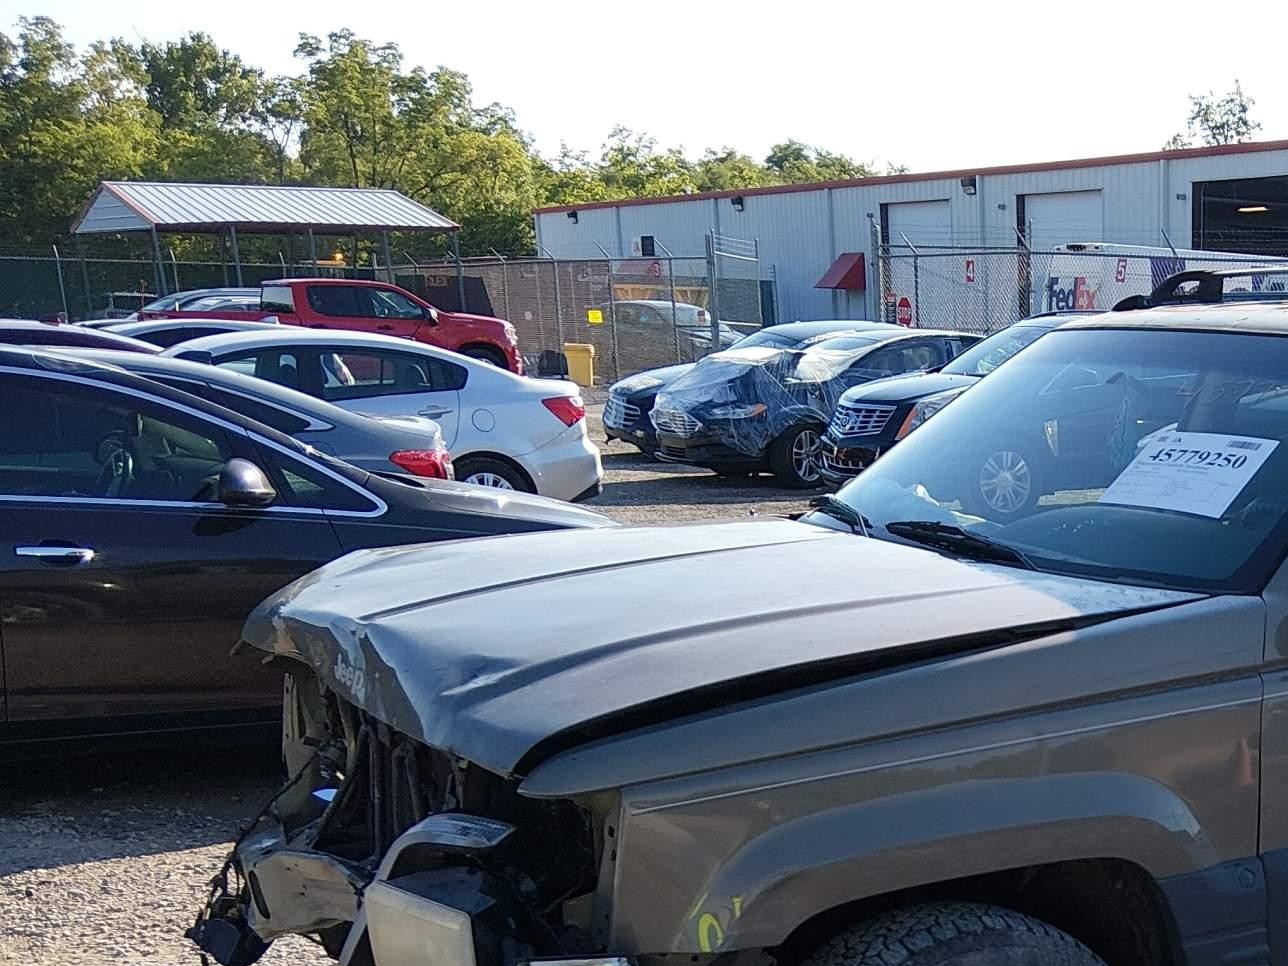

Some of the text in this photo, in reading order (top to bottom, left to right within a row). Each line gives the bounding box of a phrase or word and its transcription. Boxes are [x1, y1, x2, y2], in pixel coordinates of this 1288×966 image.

[966, 261, 974, 278] 4
[1117, 259, 1126, 281] 5
[1050, 276, 1097, 311] FedEx
[1149, 448, 1248, 469] 45779250
[333, 652, 365, 695] Jeep
